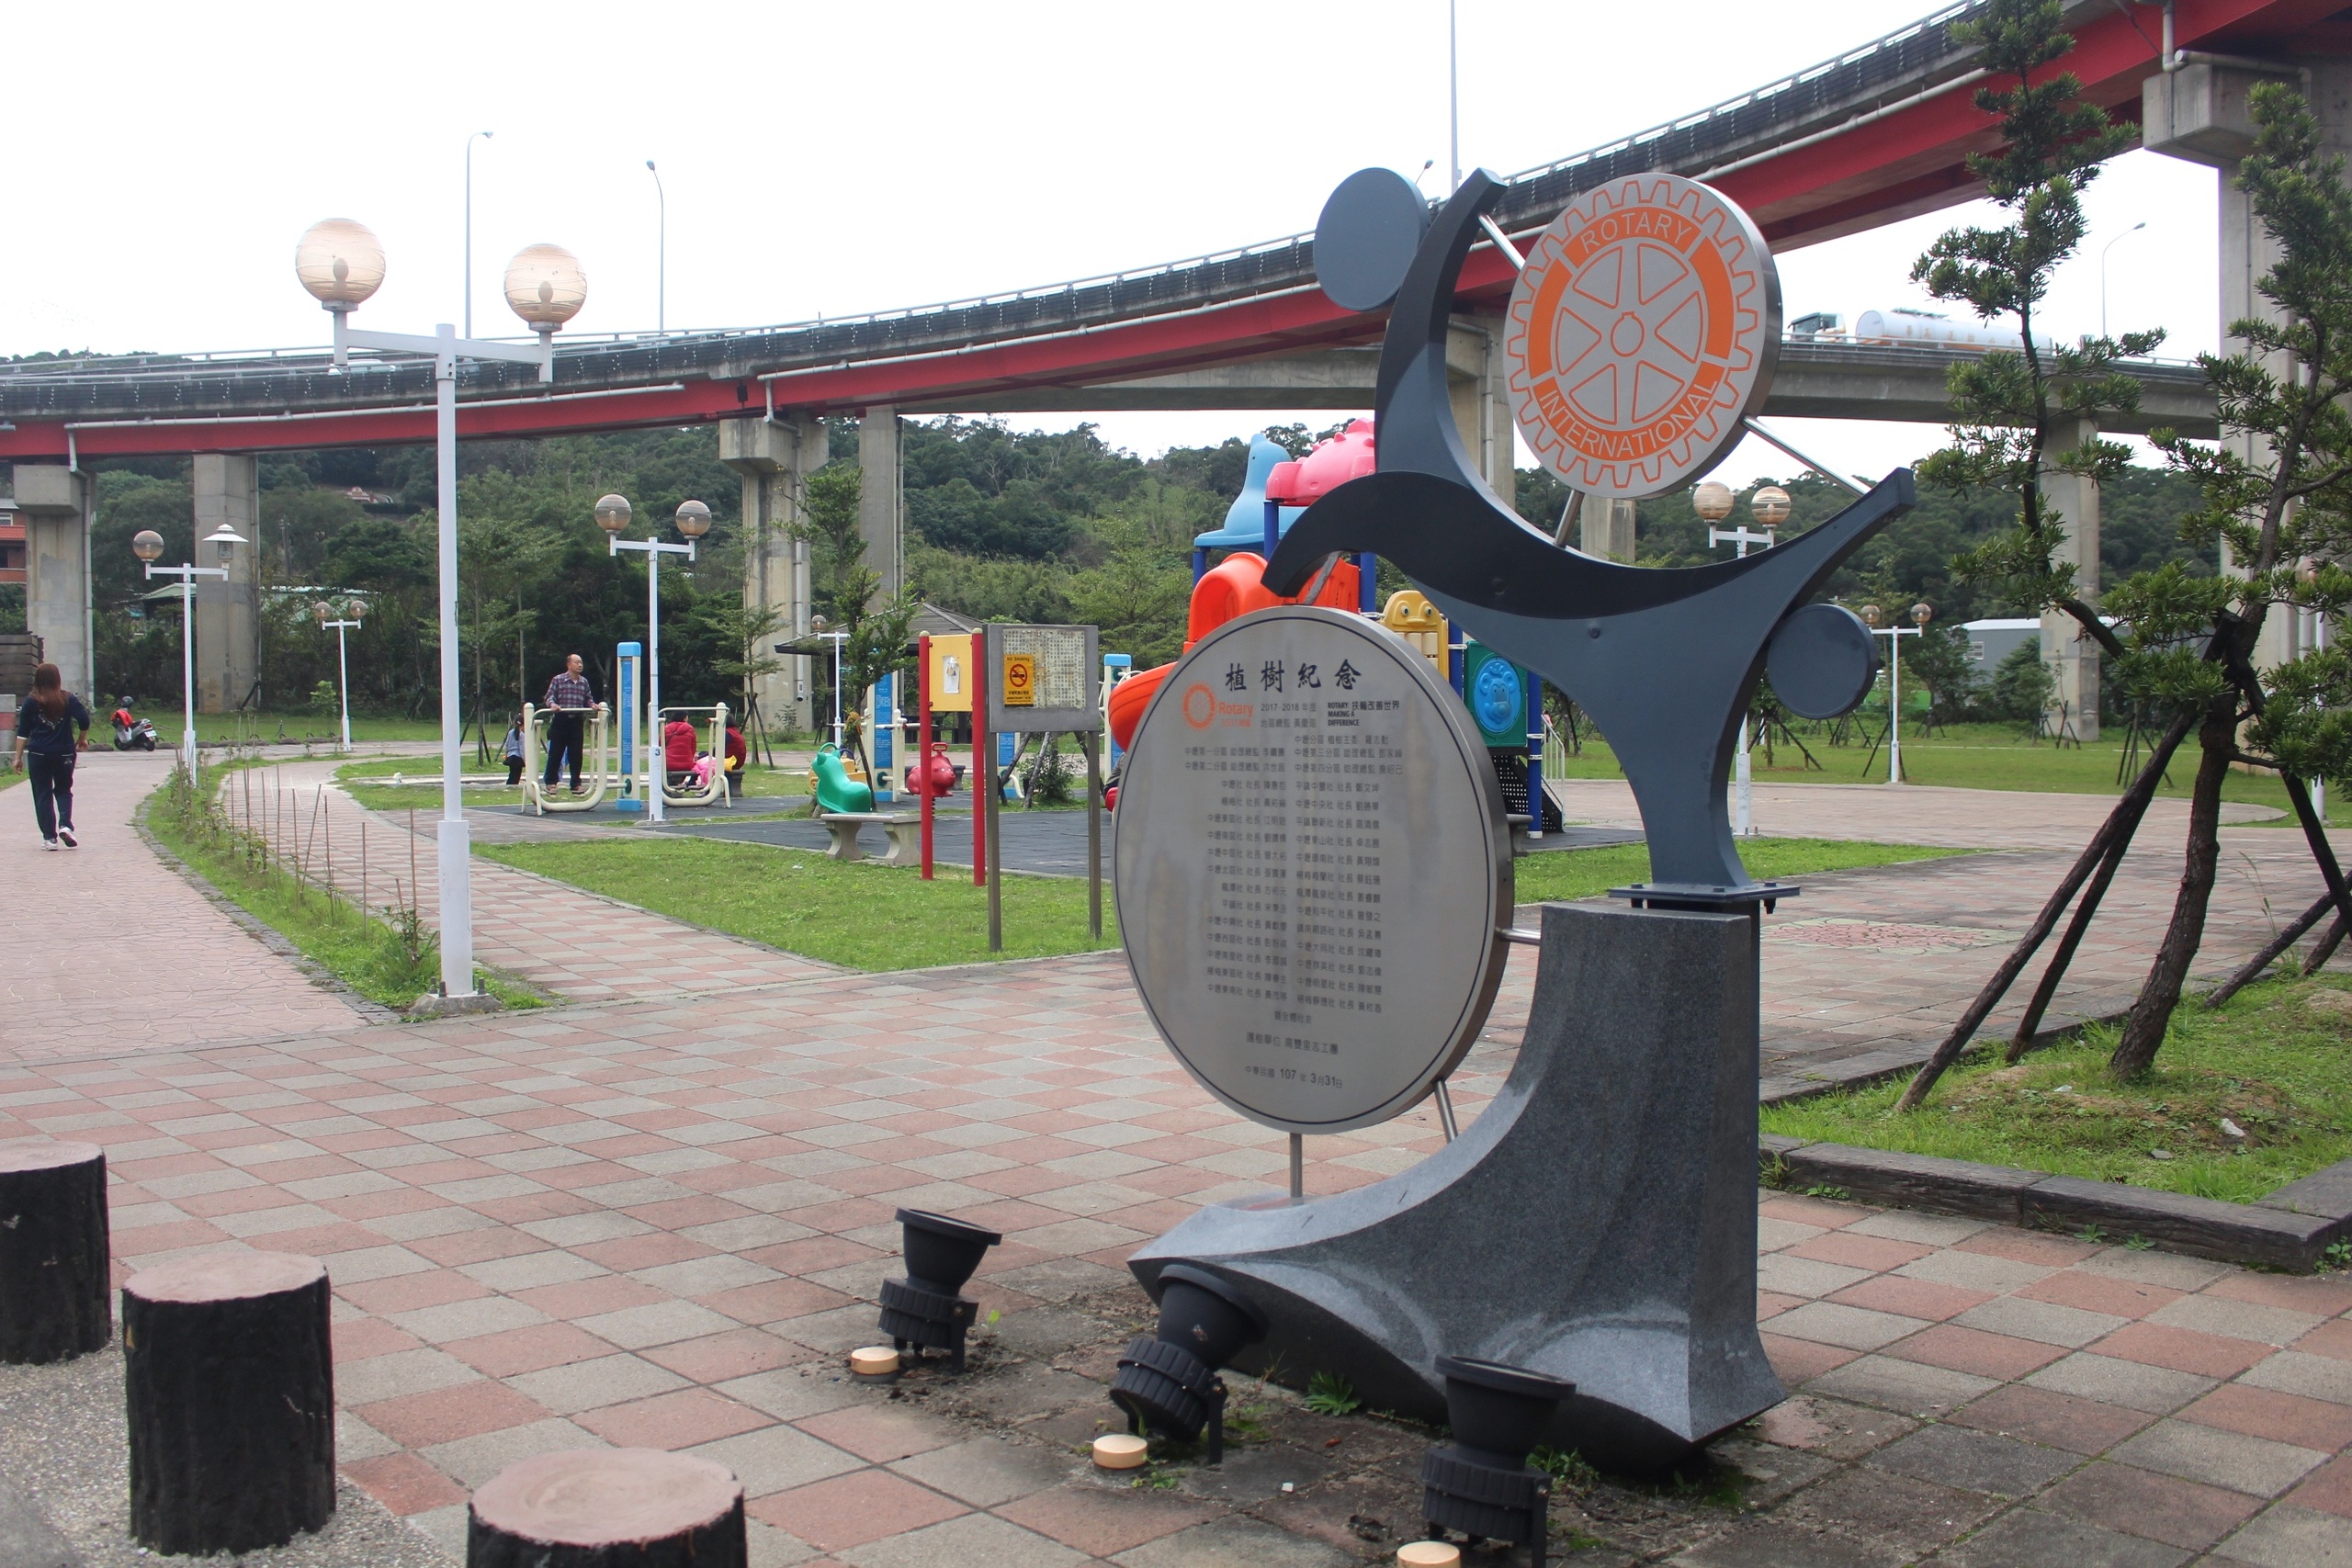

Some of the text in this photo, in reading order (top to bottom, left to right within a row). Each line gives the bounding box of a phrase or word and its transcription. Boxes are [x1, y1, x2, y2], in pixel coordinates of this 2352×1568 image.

[1579, 212, 1692, 254] ROTARY
[1538, 379, 1720, 458] INTERNATIONAL
[1225, 659, 1361, 693] 植樹紀念
[1218, 701, 1253, 718] Rotary
[1351, 700, 1399, 711] 扶輪改善世界
[1328, 719, 1359, 728] DIFFERENCE
[655, 749, 661, 757] 3
[1280, 1068, 1296, 1079] 107
